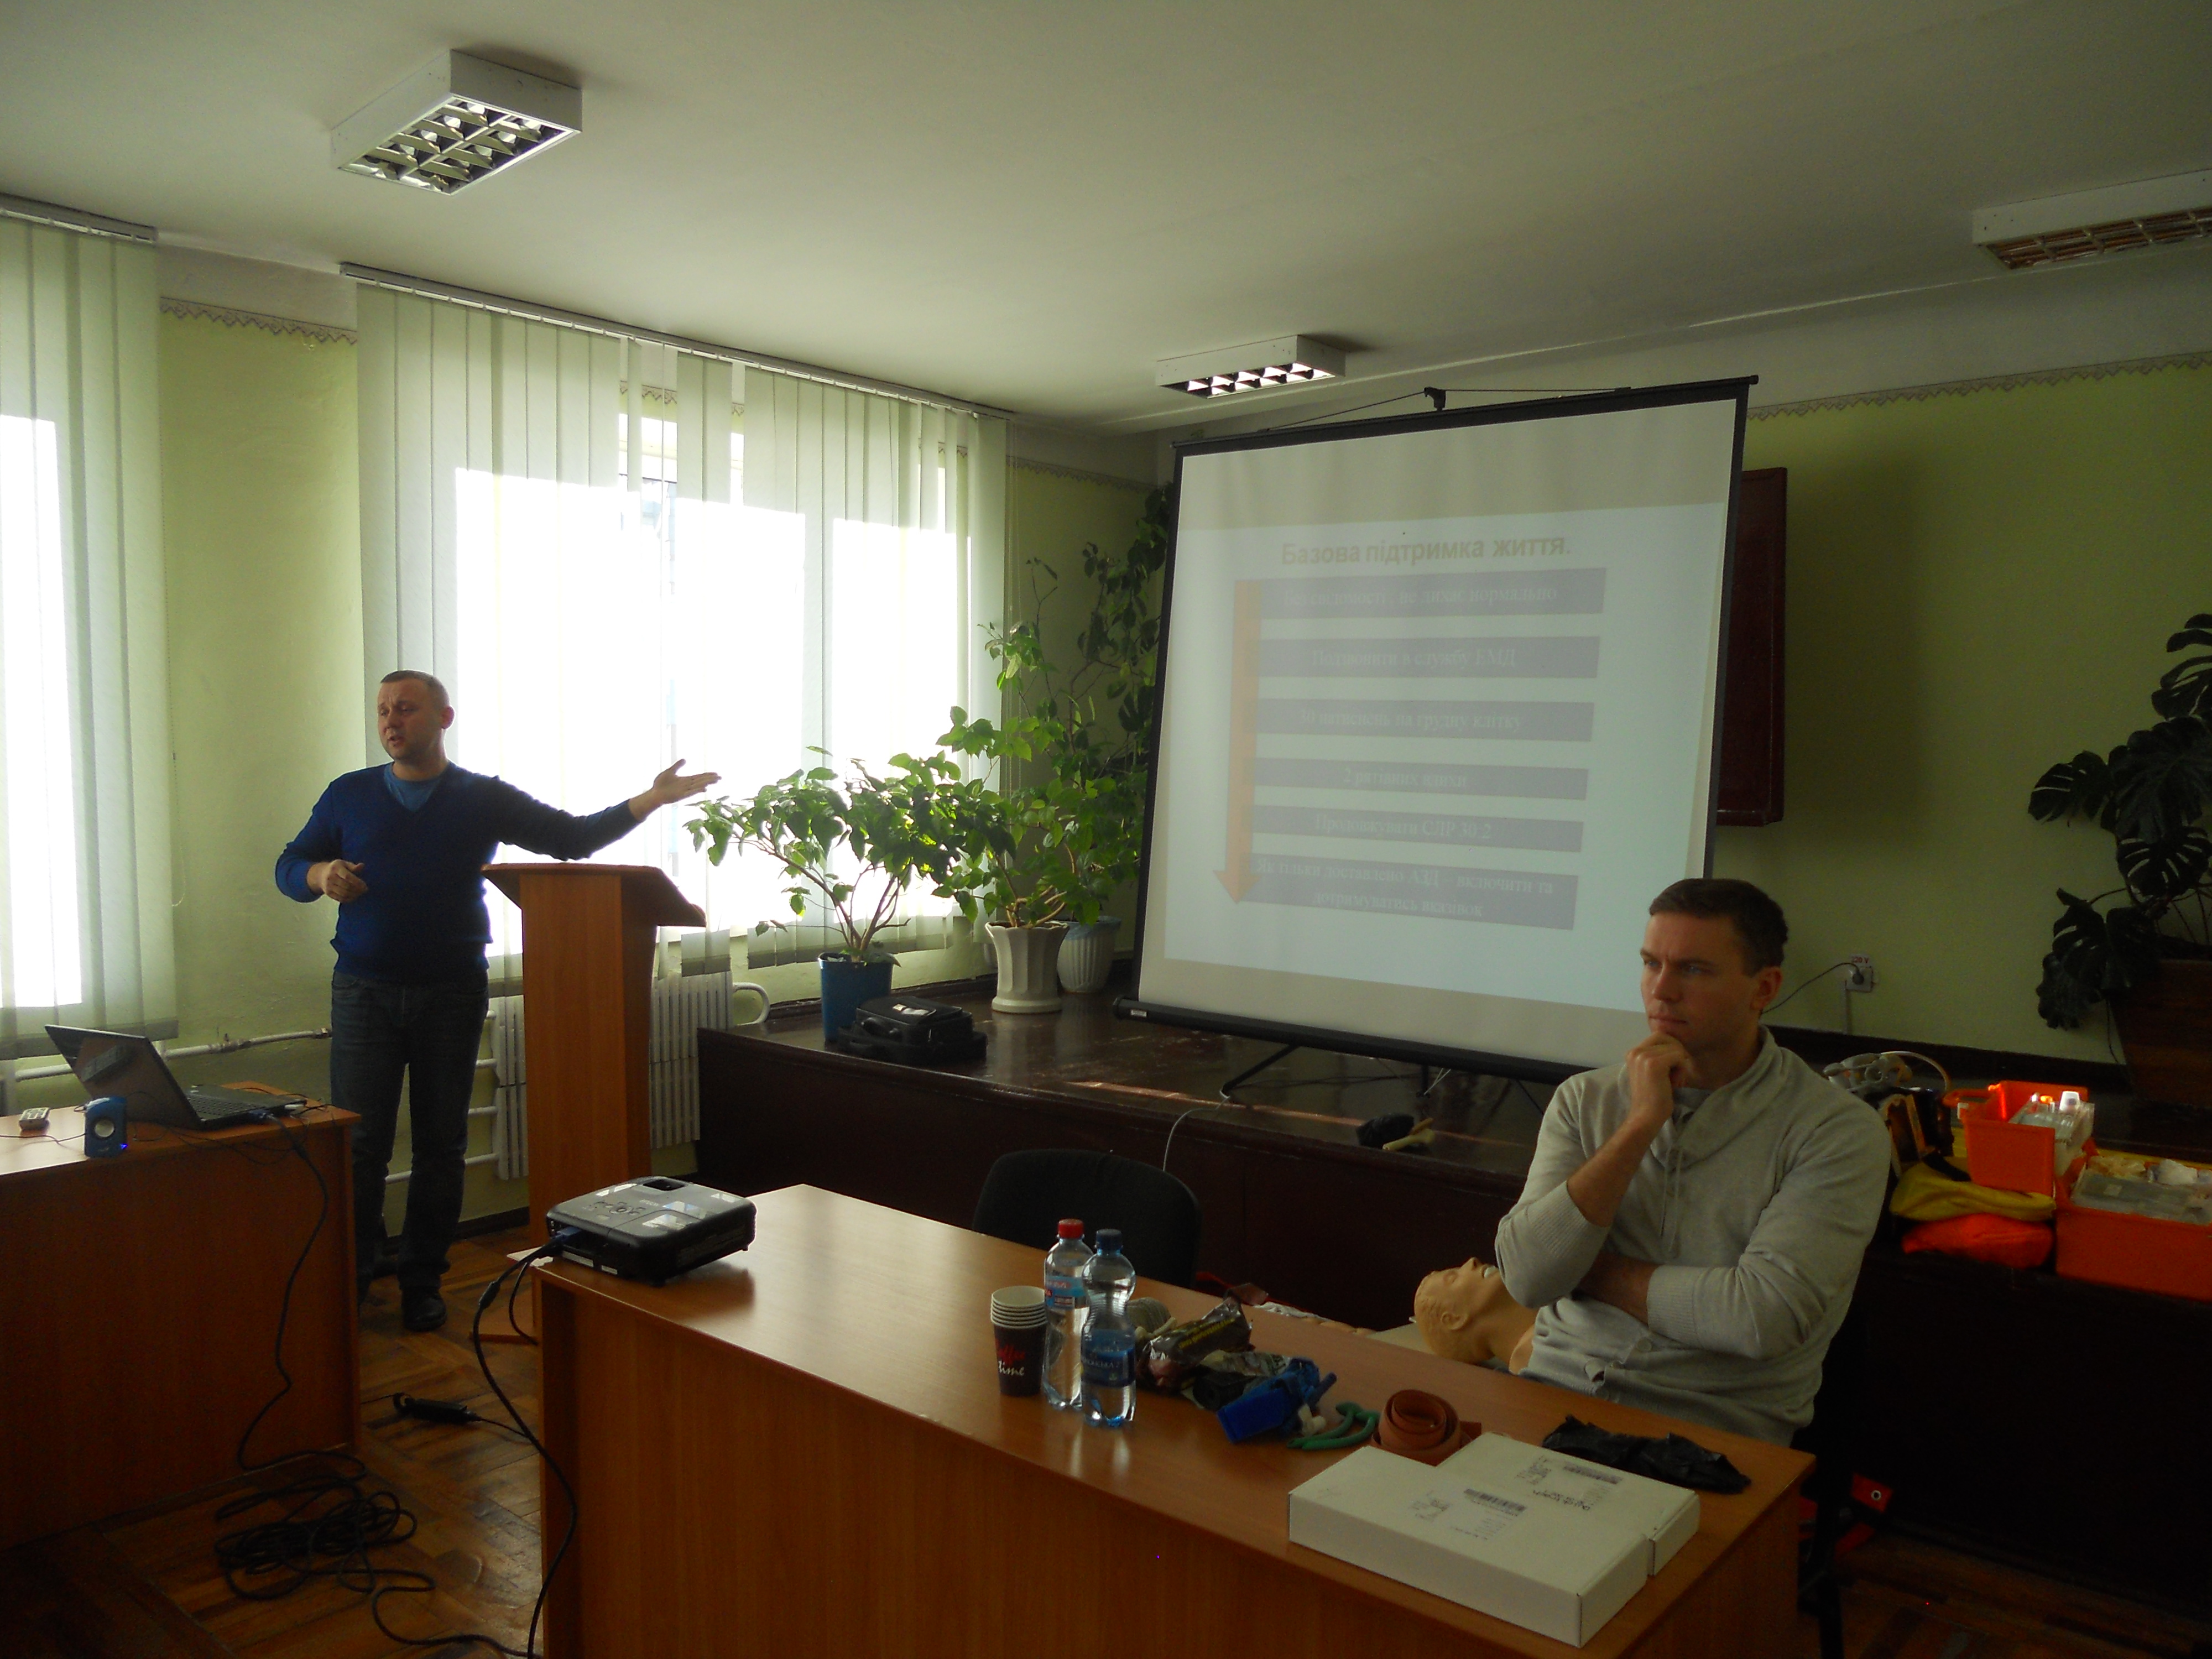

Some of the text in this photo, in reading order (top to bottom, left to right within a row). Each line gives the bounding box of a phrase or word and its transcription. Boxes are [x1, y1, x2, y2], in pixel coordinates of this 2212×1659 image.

[1282, 537, 1571, 565] Базова підтримка життя.
